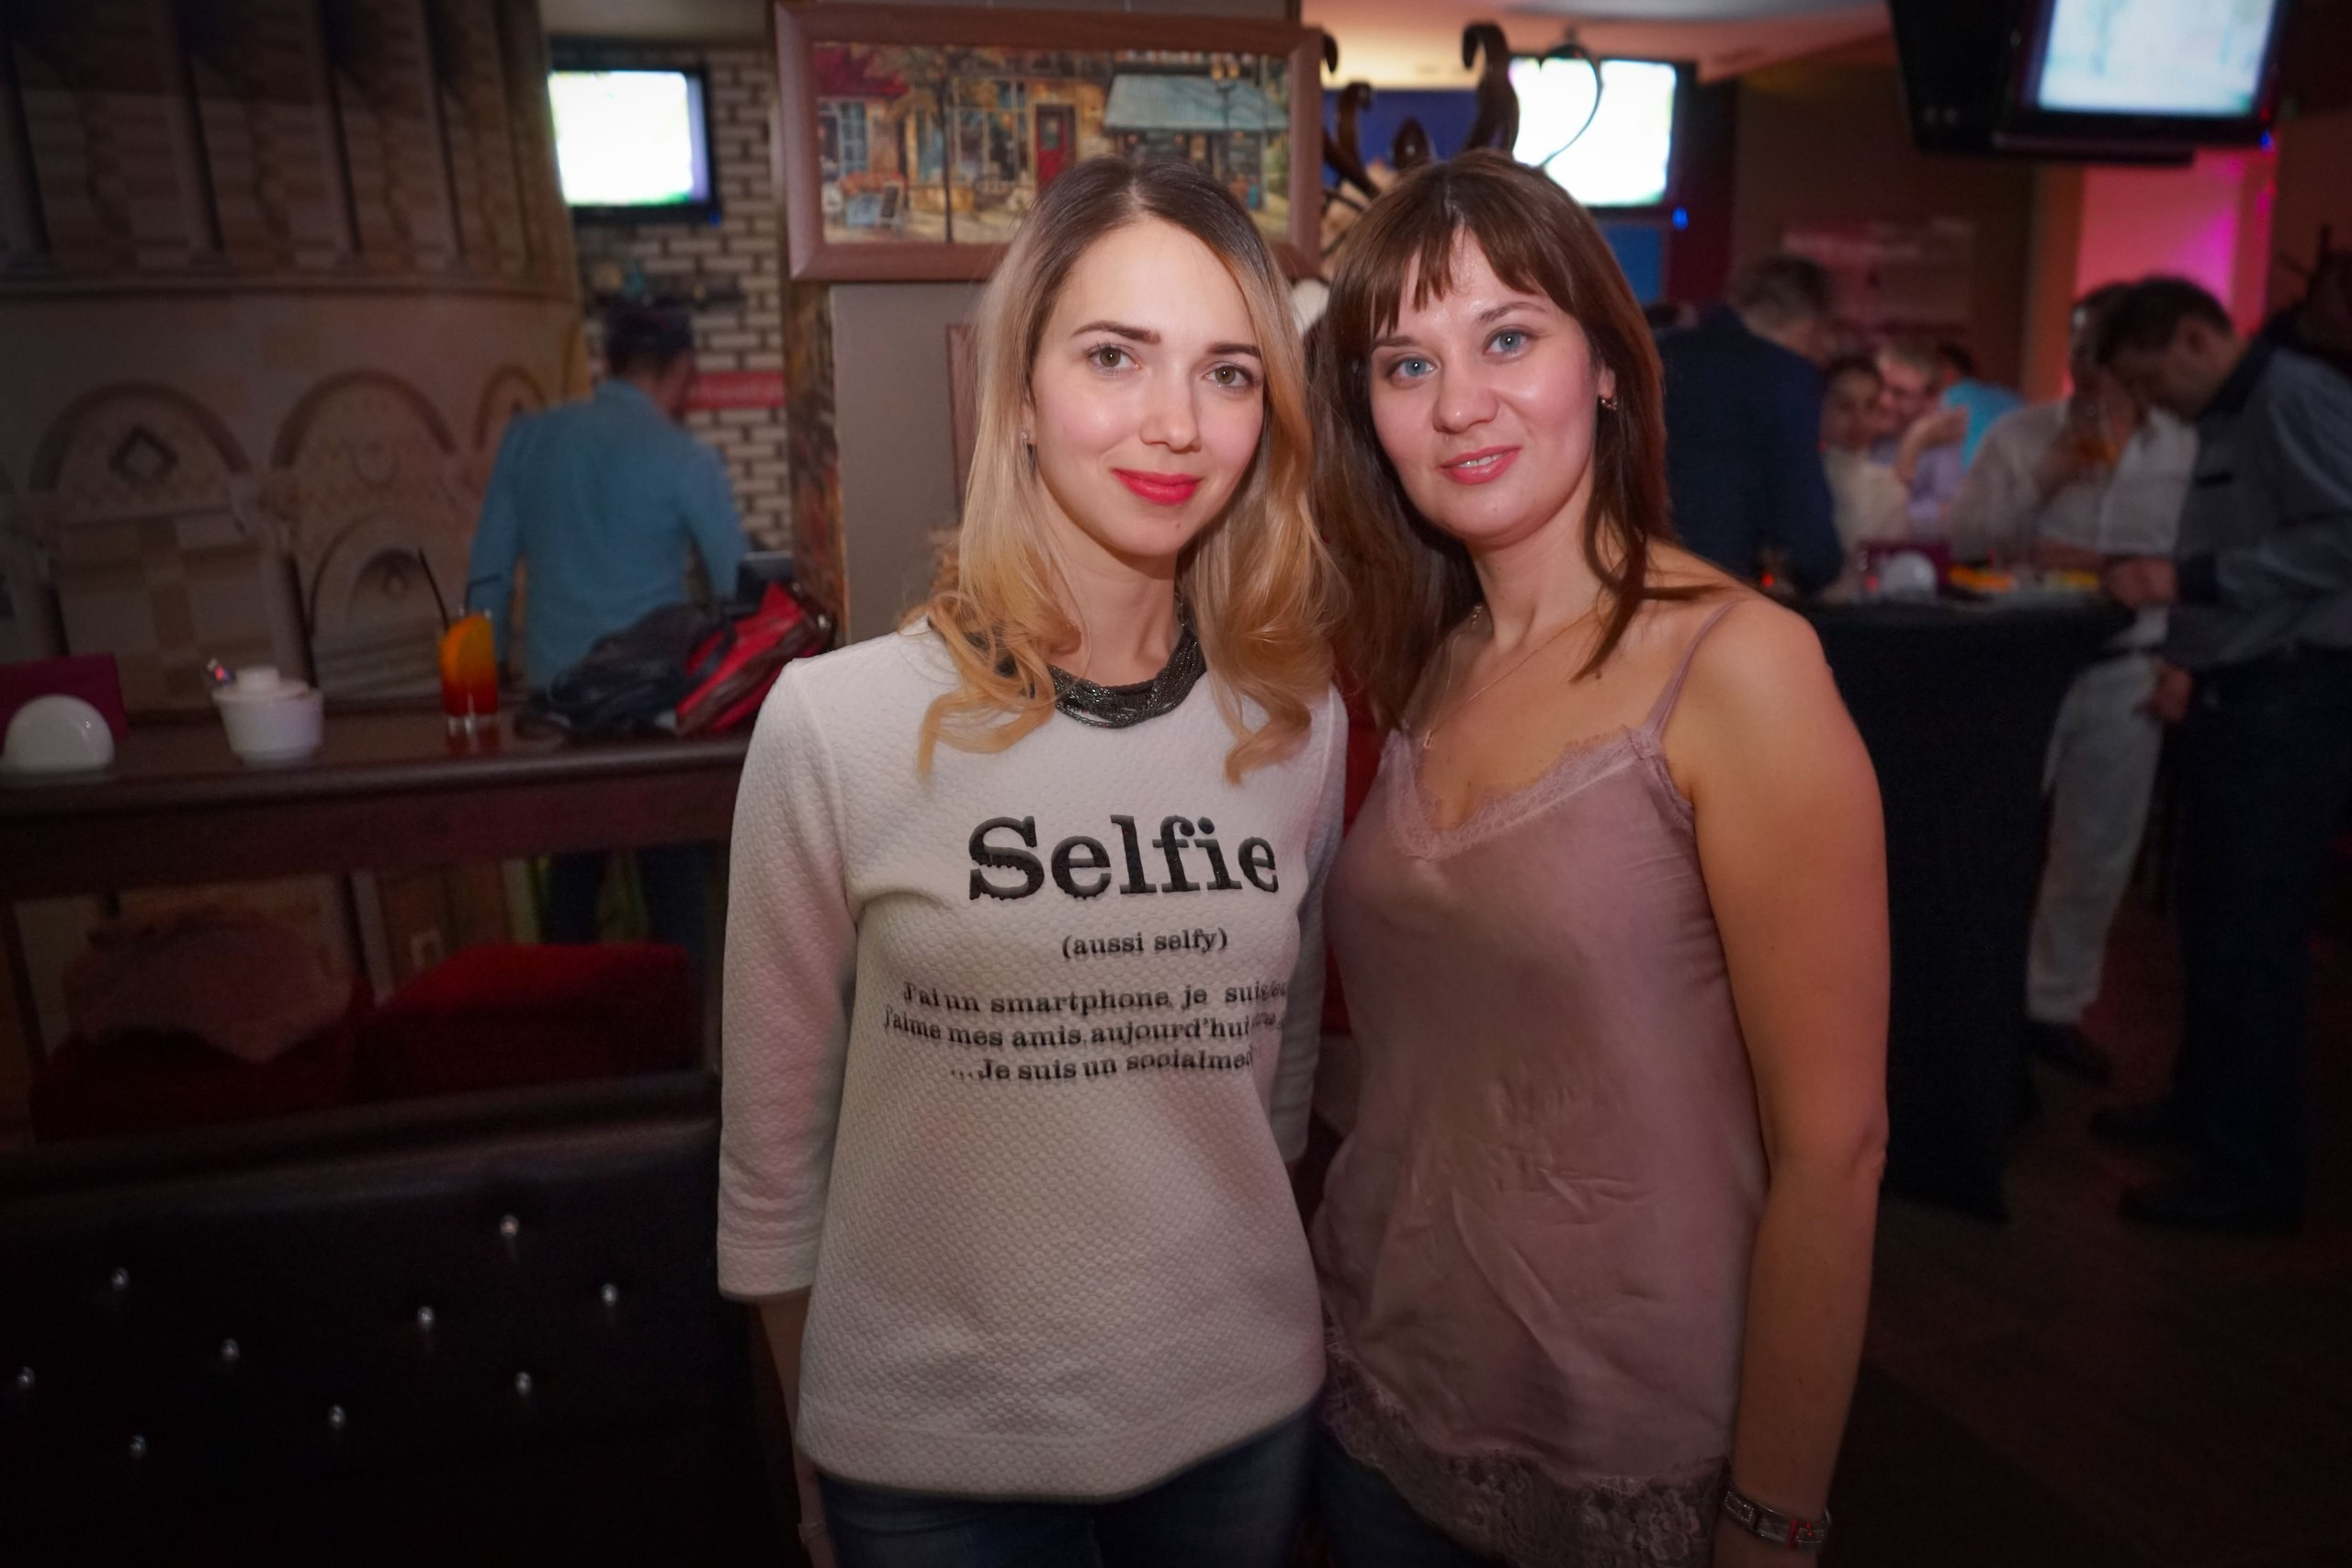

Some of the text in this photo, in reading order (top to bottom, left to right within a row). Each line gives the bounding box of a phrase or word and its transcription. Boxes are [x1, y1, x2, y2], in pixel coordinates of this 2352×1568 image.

[968, 815, 1280, 900] Selfie
[1062, 928, 1228, 959] (aussi selfy)
[943, 994, 982, 1013] un
[1181, 985, 1208, 1010] je
[947, 1025, 1004, 1047] mes
[1018, 1058, 1077, 1081] suis
[1082, 1056, 1118, 1077] un
